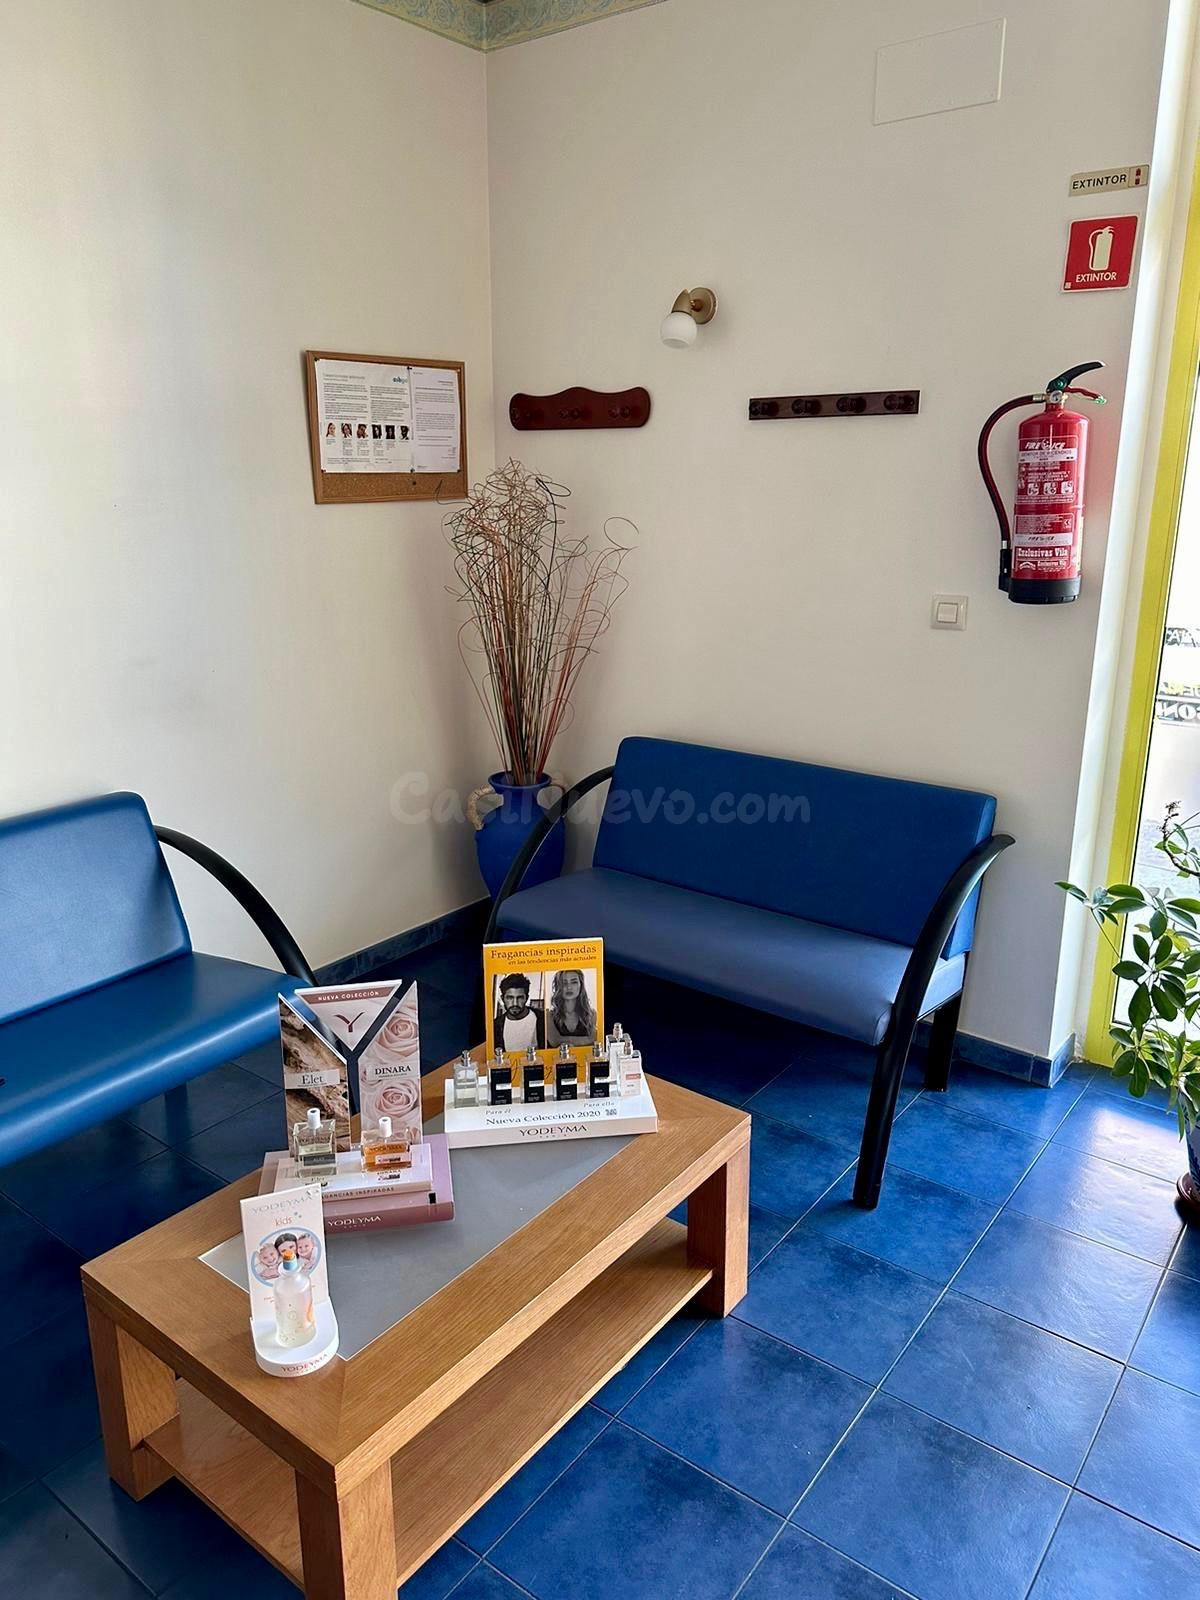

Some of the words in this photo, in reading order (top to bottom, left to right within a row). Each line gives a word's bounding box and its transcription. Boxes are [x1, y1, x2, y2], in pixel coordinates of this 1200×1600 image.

[1072, 174, 1127, 190] EXTINTOR
[1075, 272, 1117, 283] EXTINTOR
[1018, 548, 1053, 557] Exclusivas
[491, 949, 544, 960] Fragancias
[546, 945, 597, 958] inspiradas
[341, 991, 379, 999] COLECCIÓN
[375, 1065, 411, 1075] DINARA
[302, 1074, 323, 1085] Elet
[487, 1116, 521, 1125] Nueva
[524, 1112, 575, 1122] Colección
[577, 1110, 601, 1118] 2020
[519, 1124, 588, 1137] YODEYMA
[355, 1187, 395, 1196] INSPIRADAS
